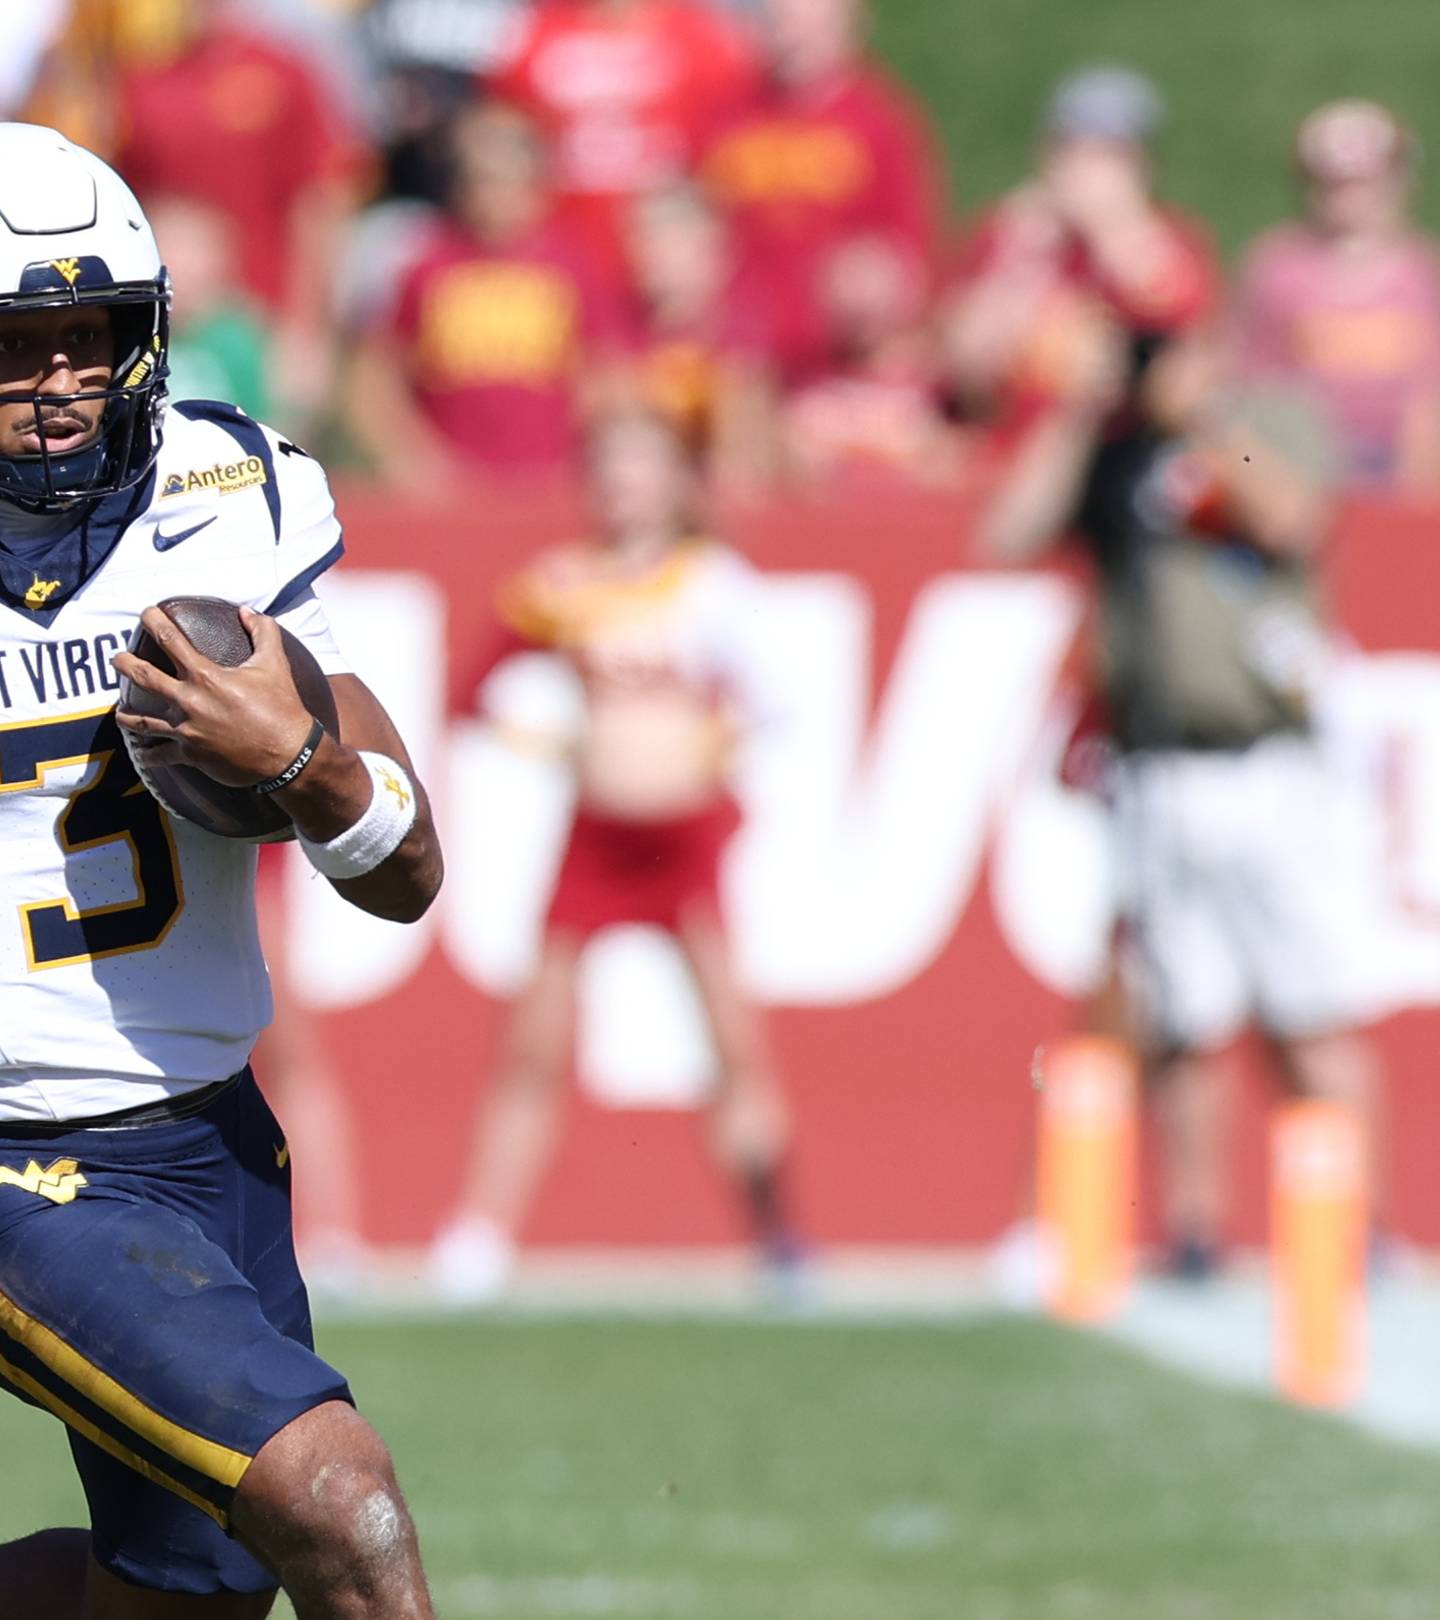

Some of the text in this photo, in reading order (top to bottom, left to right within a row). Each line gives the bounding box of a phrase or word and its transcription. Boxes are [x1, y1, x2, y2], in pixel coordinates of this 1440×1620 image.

[187, 458, 260, 491] Antero
[19, 629, 133, 704] VIRG
[282, 747, 312, 782] STACK
